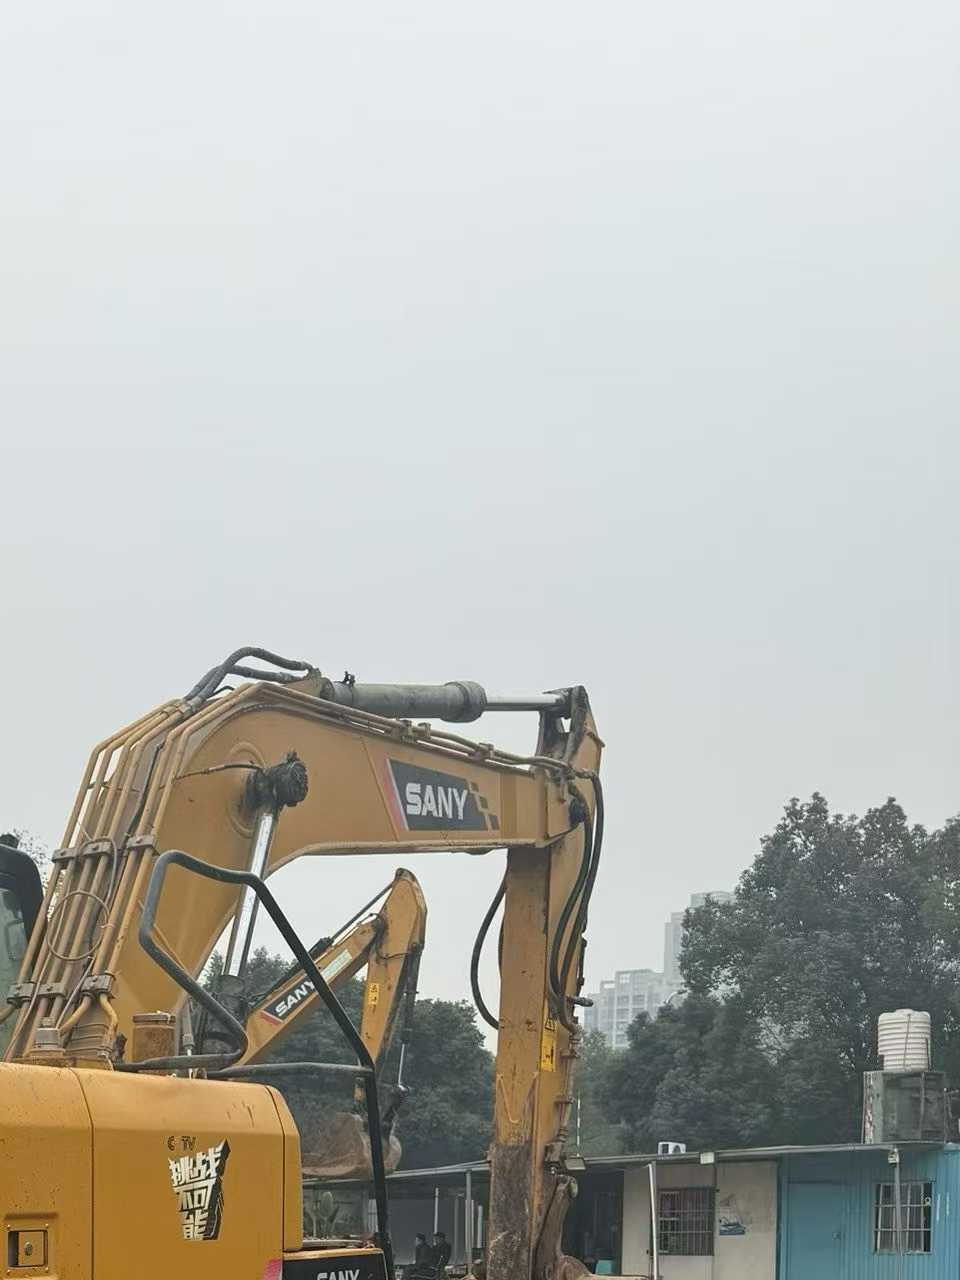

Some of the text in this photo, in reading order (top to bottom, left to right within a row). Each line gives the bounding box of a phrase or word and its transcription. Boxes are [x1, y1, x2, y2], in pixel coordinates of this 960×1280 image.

[405, 781, 468, 821] SANY
[167, 1142, 223, 1187] 挑战
[172, 1177, 217, 1212] 不可
[181, 1209, 210, 1241] 能
